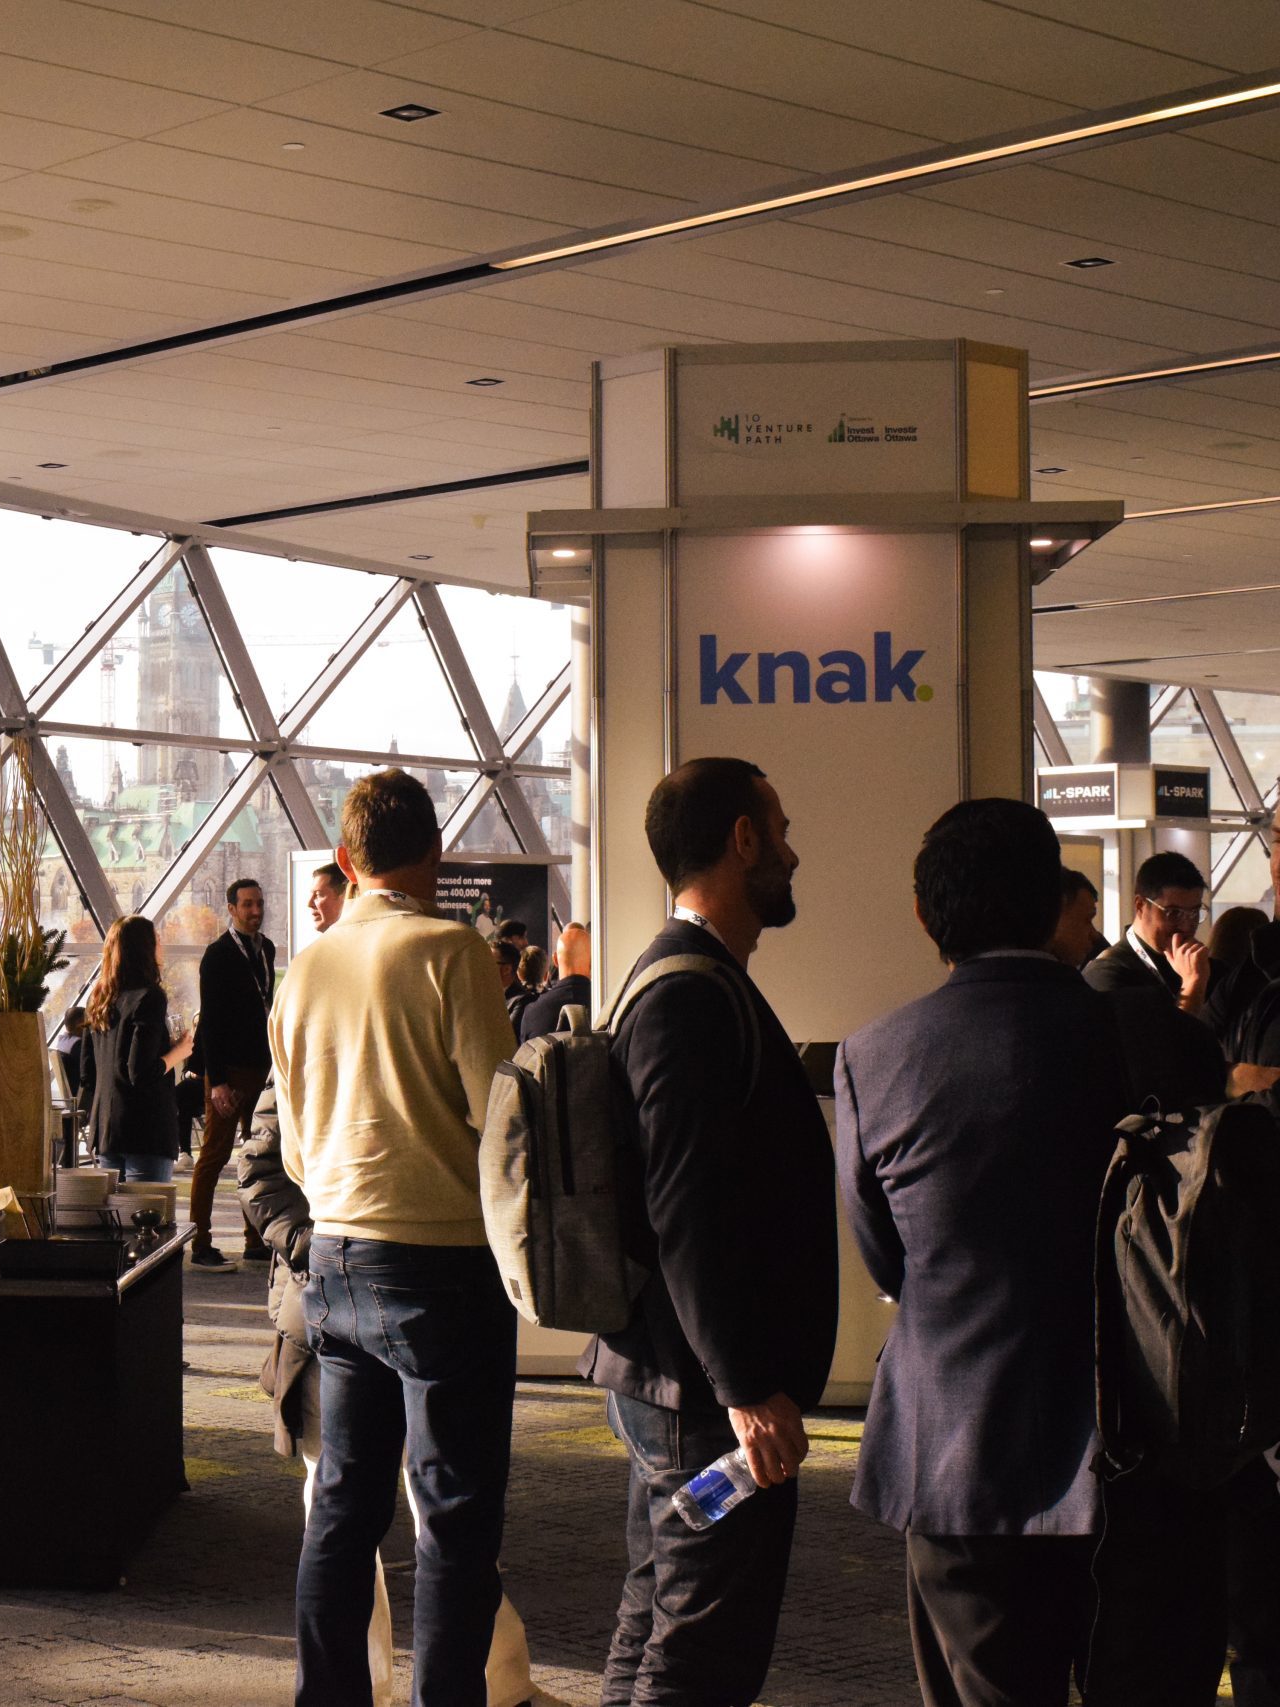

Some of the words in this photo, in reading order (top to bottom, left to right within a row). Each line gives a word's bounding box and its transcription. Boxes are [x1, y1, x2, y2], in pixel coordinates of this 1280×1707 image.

[745, 424, 813, 433] VENTURE
[847, 426, 875, 434] Invest
[884, 426, 917, 434] Investir
[745, 435, 782, 444] PATH
[847, 434, 880, 442] Ottawa
[884, 434, 917, 442] Ottawa
[1053, 785, 1110, 799] L-SPARK
[1164, 785, 1204, 798] L-SPARK
[450, 888, 480, 898] 400,000
